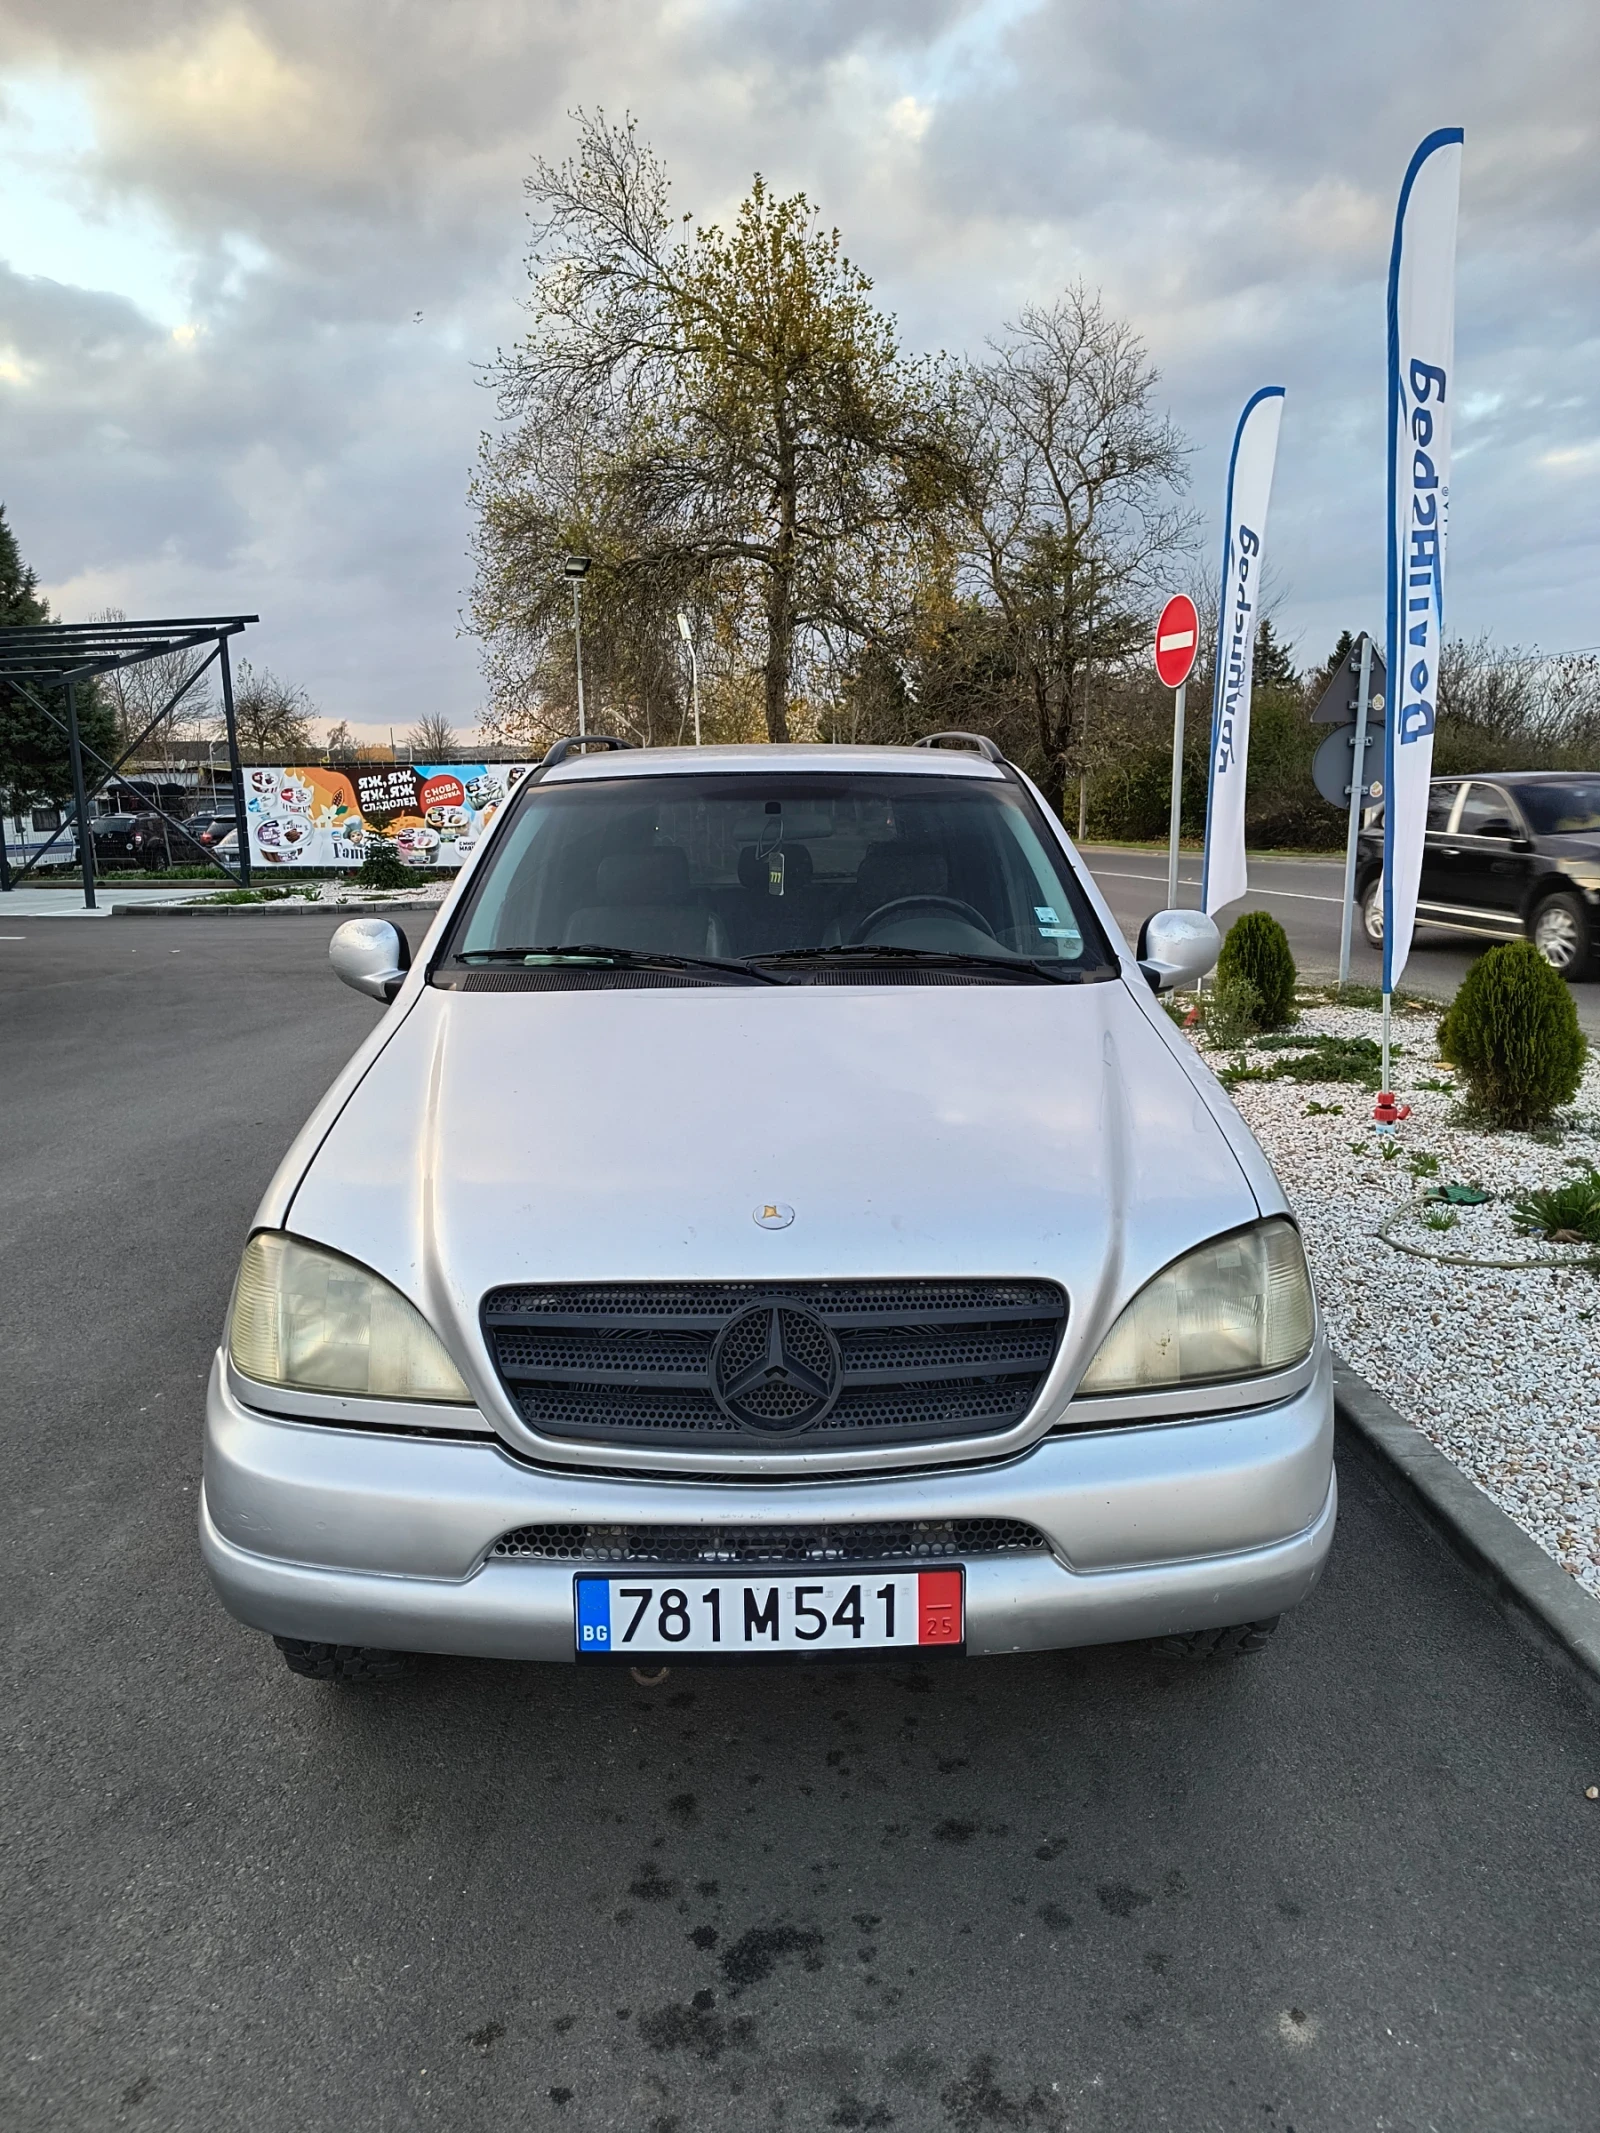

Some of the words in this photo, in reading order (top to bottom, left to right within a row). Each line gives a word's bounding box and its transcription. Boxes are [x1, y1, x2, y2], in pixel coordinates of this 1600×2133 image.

[358, 775, 387, 789] ЯЖ,
[388, 770, 416, 785] ЯЖ,
[390, 783, 415, 798] ЯЖ
[424, 790, 431, 798] С
[431, 782, 459, 796] НОВА
[426, 790, 461, 804] ОПАКОВКА
[362, 796, 418, 812] СЛАДОЛЕД
[619, 1588, 721, 1643] 781
[743, 1587, 779, 1642] M
[794, 1583, 895, 1641] 541
[583, 1625, 608, 1642] BG
[926, 1616, 953, 1636] 25
